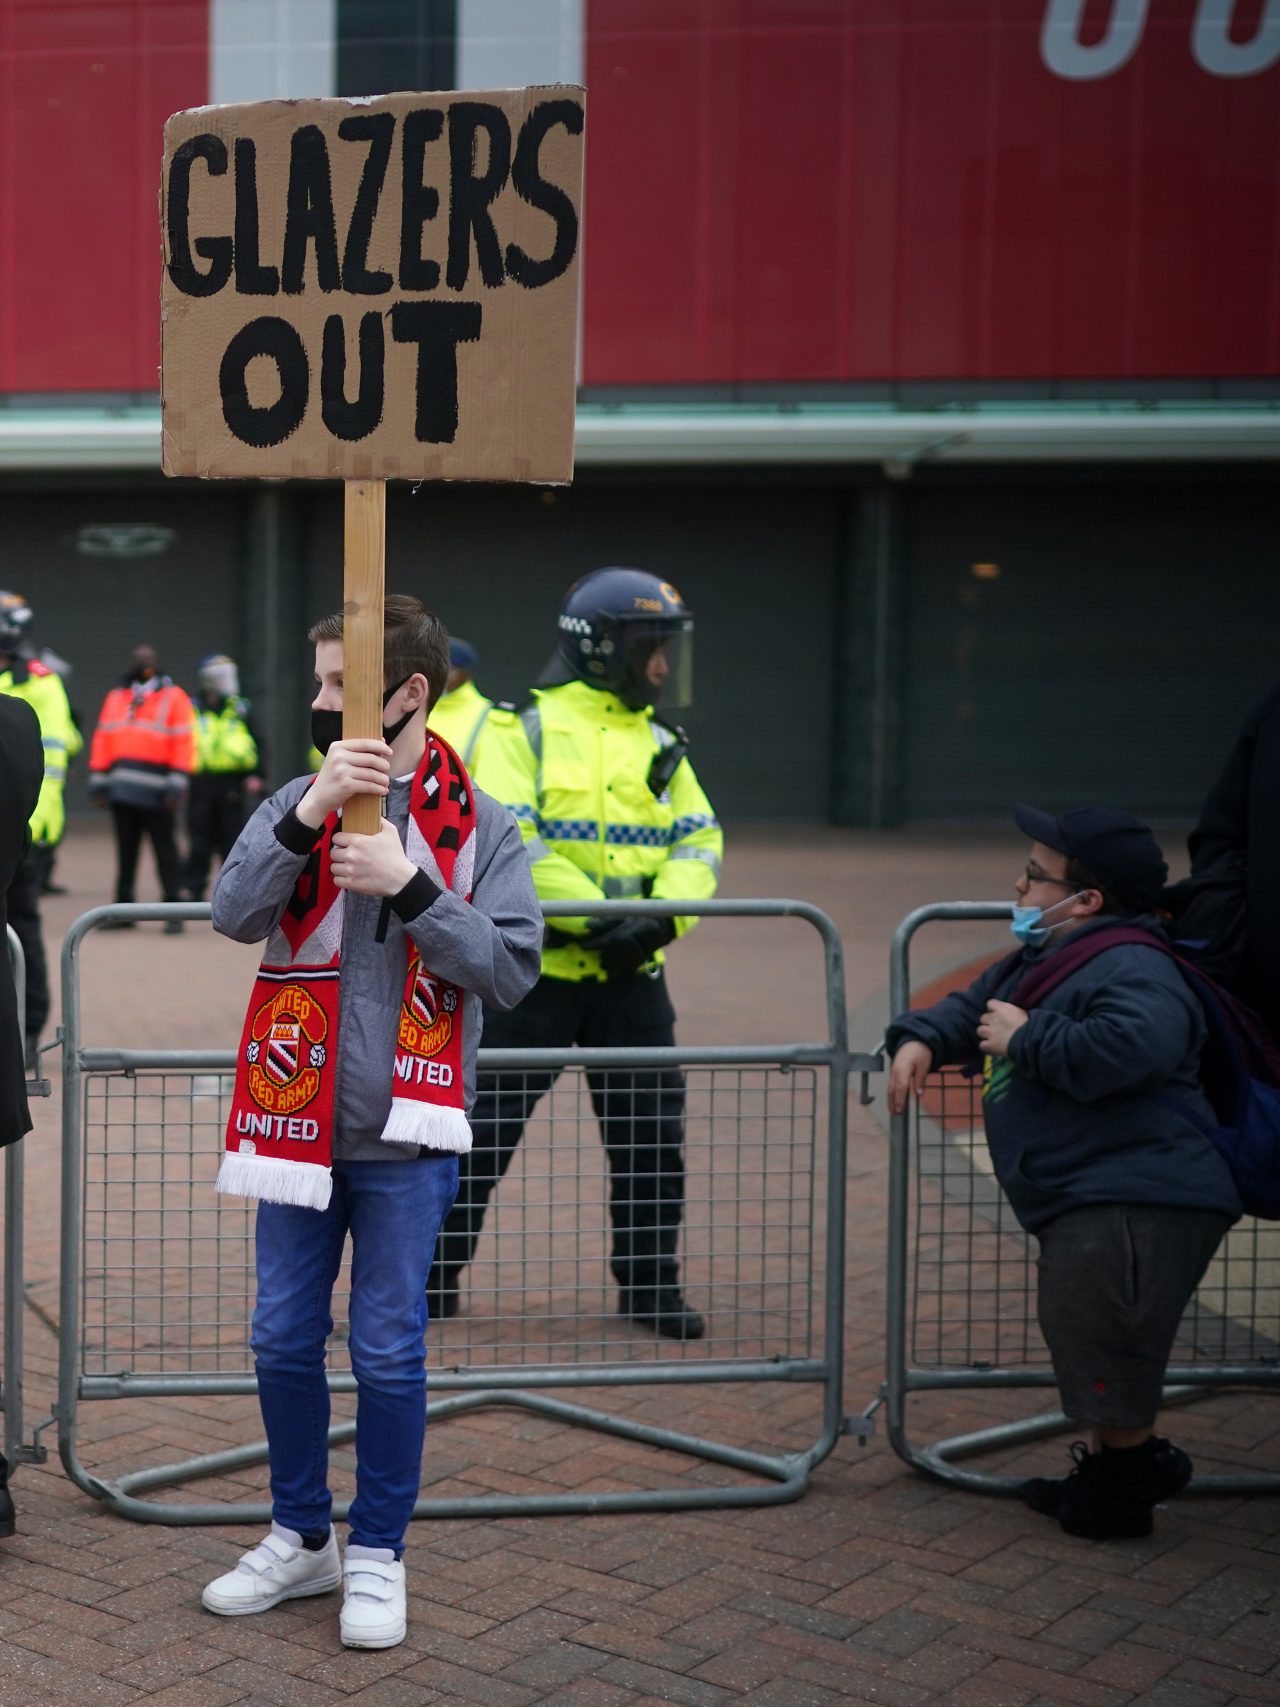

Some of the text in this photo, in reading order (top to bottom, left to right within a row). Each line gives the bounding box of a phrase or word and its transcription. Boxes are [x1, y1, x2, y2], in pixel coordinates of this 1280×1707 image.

[167, 99, 585, 298] GLAZERS
[219, 299, 483, 449] OUT
[271, 989, 310, 1020] UNITED
[399, 1018, 449, 1052] ED ARMY
[392, 1054, 454, 1088] NITED
[251, 1070, 315, 1110] RED ARMY
[235, 1108, 320, 1142] UNITED
